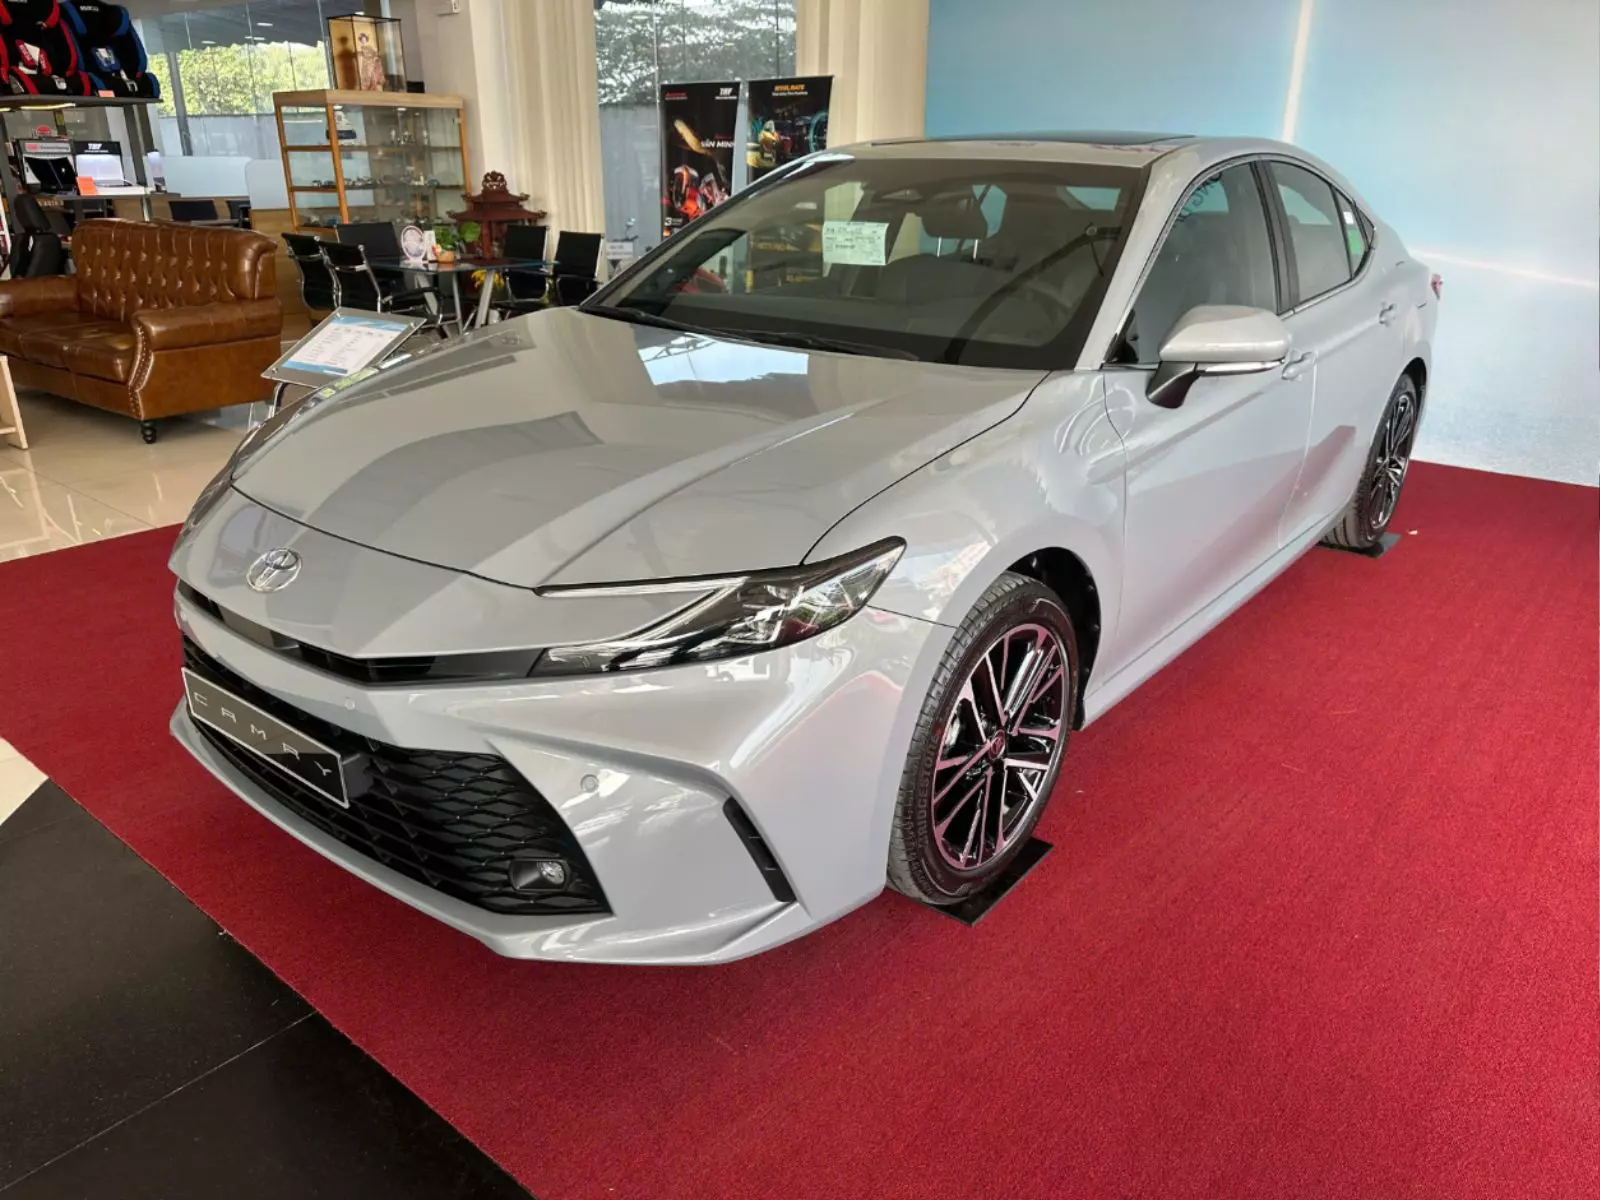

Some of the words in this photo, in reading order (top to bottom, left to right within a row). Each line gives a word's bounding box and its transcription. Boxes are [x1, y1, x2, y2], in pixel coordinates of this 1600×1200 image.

[664, 217, 673, 226] 3
[193, 691, 332, 776] CAMRY
[916, 734, 941, 849] BRIDGESTONE
